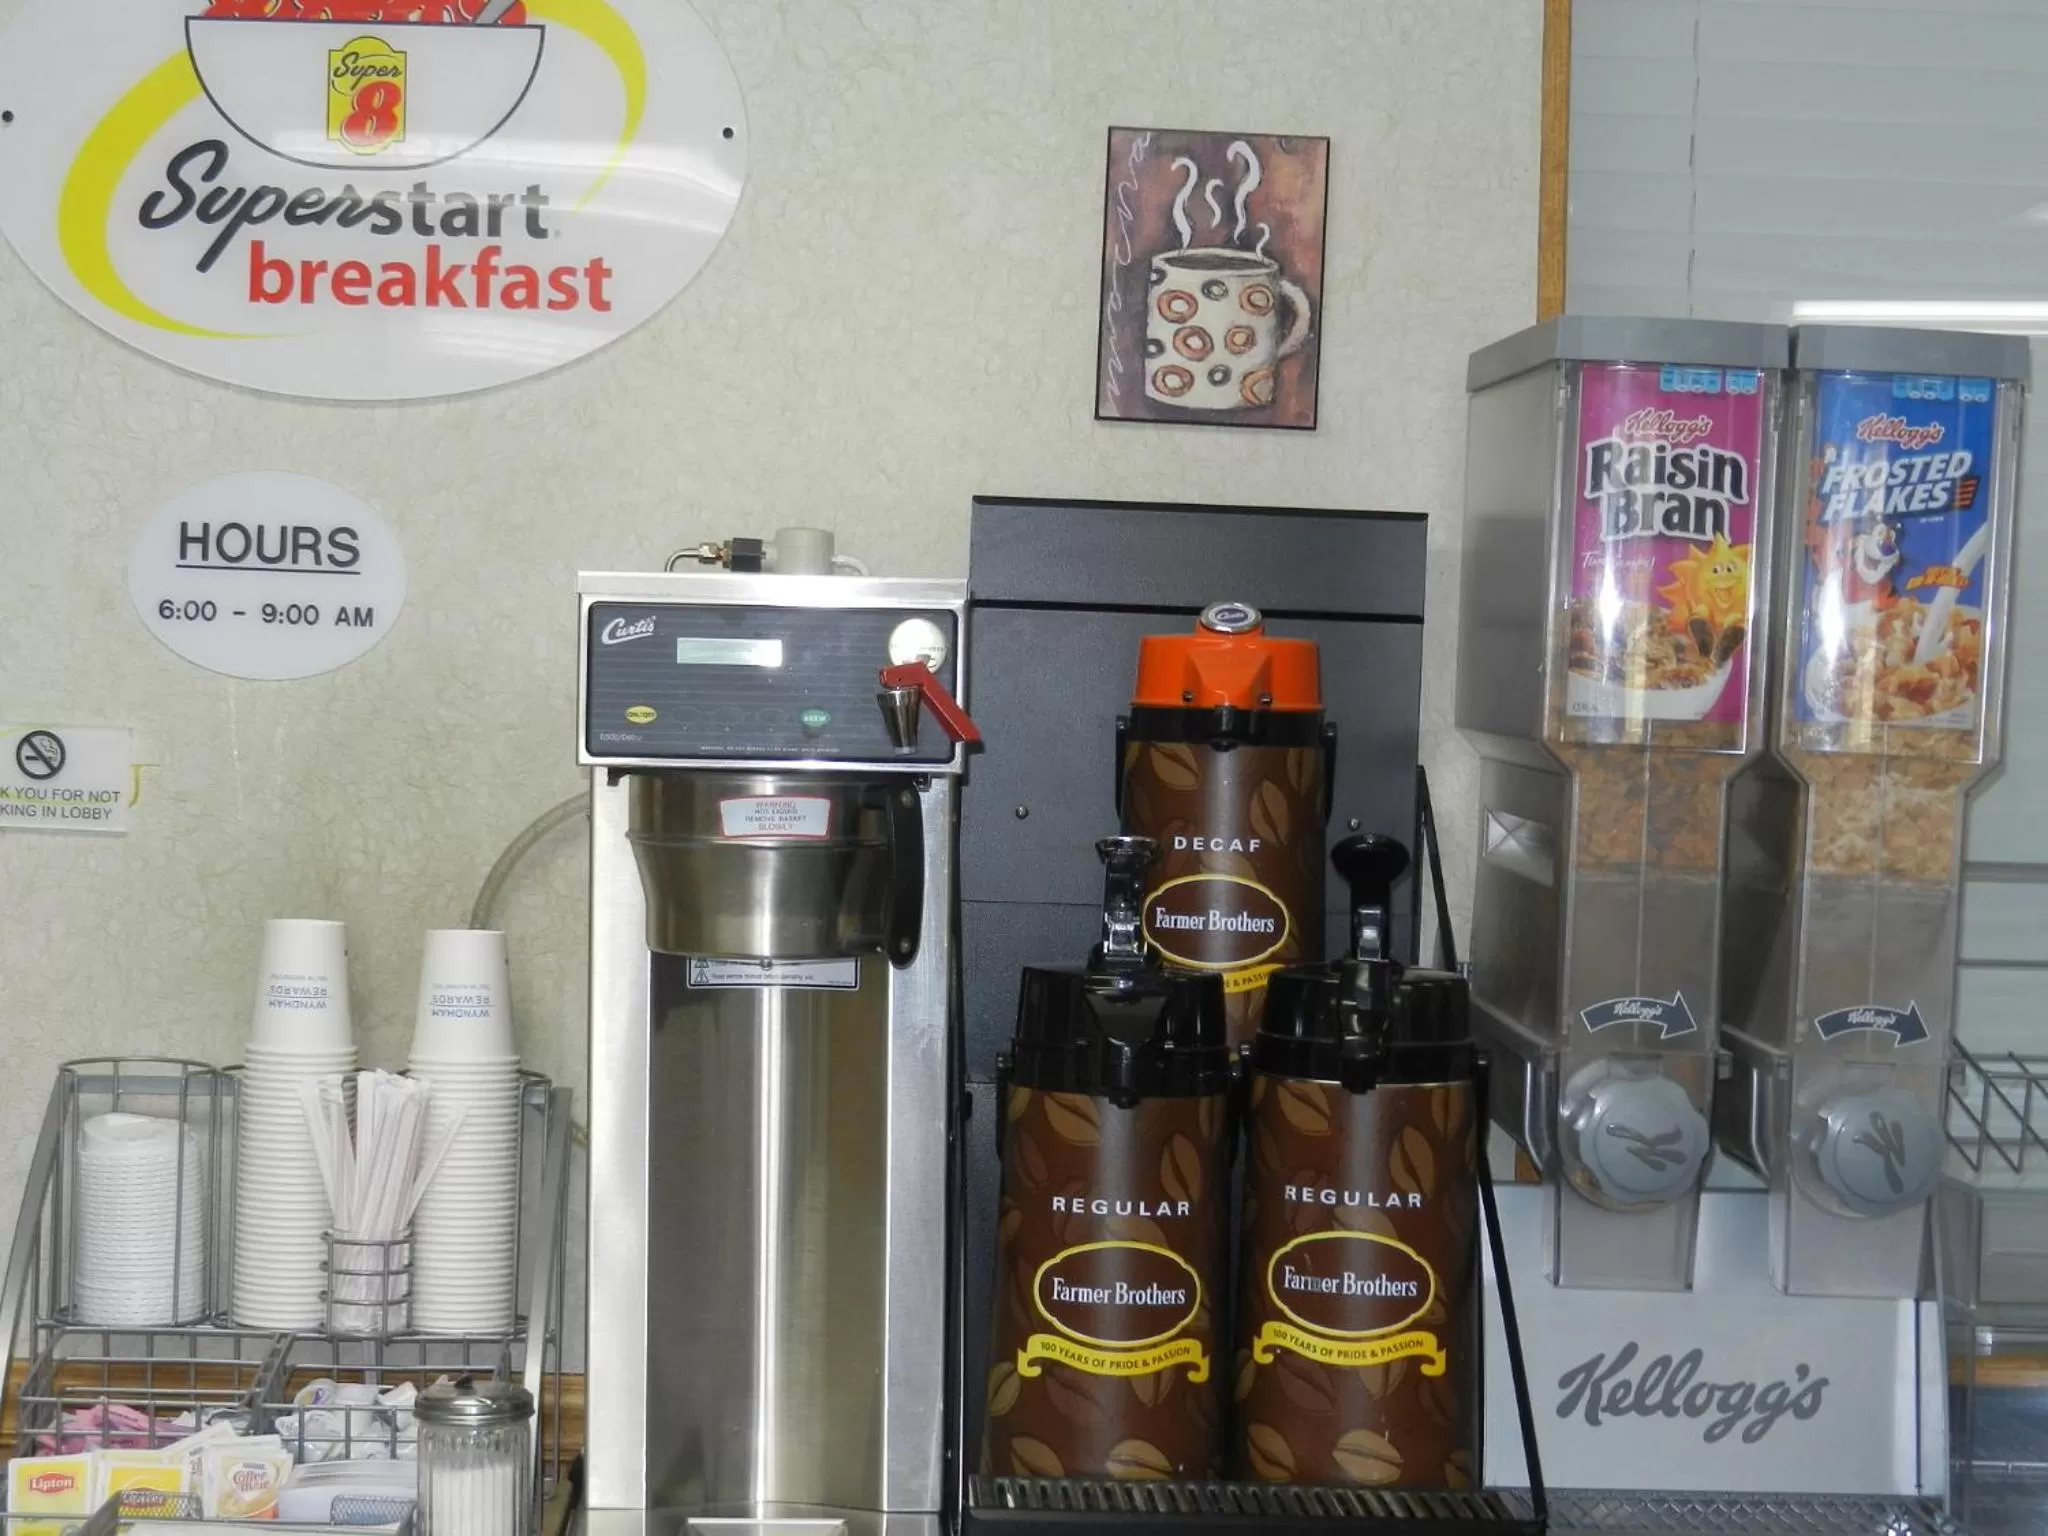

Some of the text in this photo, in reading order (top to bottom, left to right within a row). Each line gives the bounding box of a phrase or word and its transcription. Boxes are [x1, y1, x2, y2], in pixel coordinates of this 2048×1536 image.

[333, 51, 402, 91] Super
[340, 80, 402, 148] 8
[248, 240, 612, 312] breakfast
[1626, 408, 1712, 442] Kellogg's
[1857, 414, 1943, 448] Kellogg's
[1588, 440, 1746, 502] Raisin
[1822, 452, 1972, 494] FROSTED
[1604, 489, 1729, 540] Bran
[1822, 481, 1951, 522] FLAKES
[180, 521, 360, 568] HOURS
[159, 598, 217, 622] 6:00
[261, 602, 320, 626] 9:00
[335, 606, 374, 627] AM
[601, 616, 656, 645] Curtis
[15, 787, 47, 801] YOU
[52, 788, 84, 802] FOR
[88, 790, 120, 804] NOT
[42, 805, 57, 818] IN
[61, 806, 112, 820] LOBBY
[1174, 836, 1260, 852] DECAF
[1155, 907, 1275, 933] Farmer Brothers
[268, 1000, 328, 1009] WYNDHAM
[431, 1009, 490, 1018] WYNDHAM
[1613, 1001, 1663, 1020] Kellogg's
[1052, 1196, 1189, 1216] REGULAR
[1284, 1185, 1421, 1208] REGULAR
[1053, 1277, 1186, 1306] Farmer Brothers
[1283, 1265, 1417, 1297] Farmer Brothers
[1040, 1341, 1191, 1369] 100 YEARS OF PRIDE & PASSION
[1272, 1328, 1424, 1359] 100 YEARS OF PRIDE & PASSION
[1555, 1341, 1830, 1444] Kellogg's
[32, 1478, 73, 1492] Lipton
